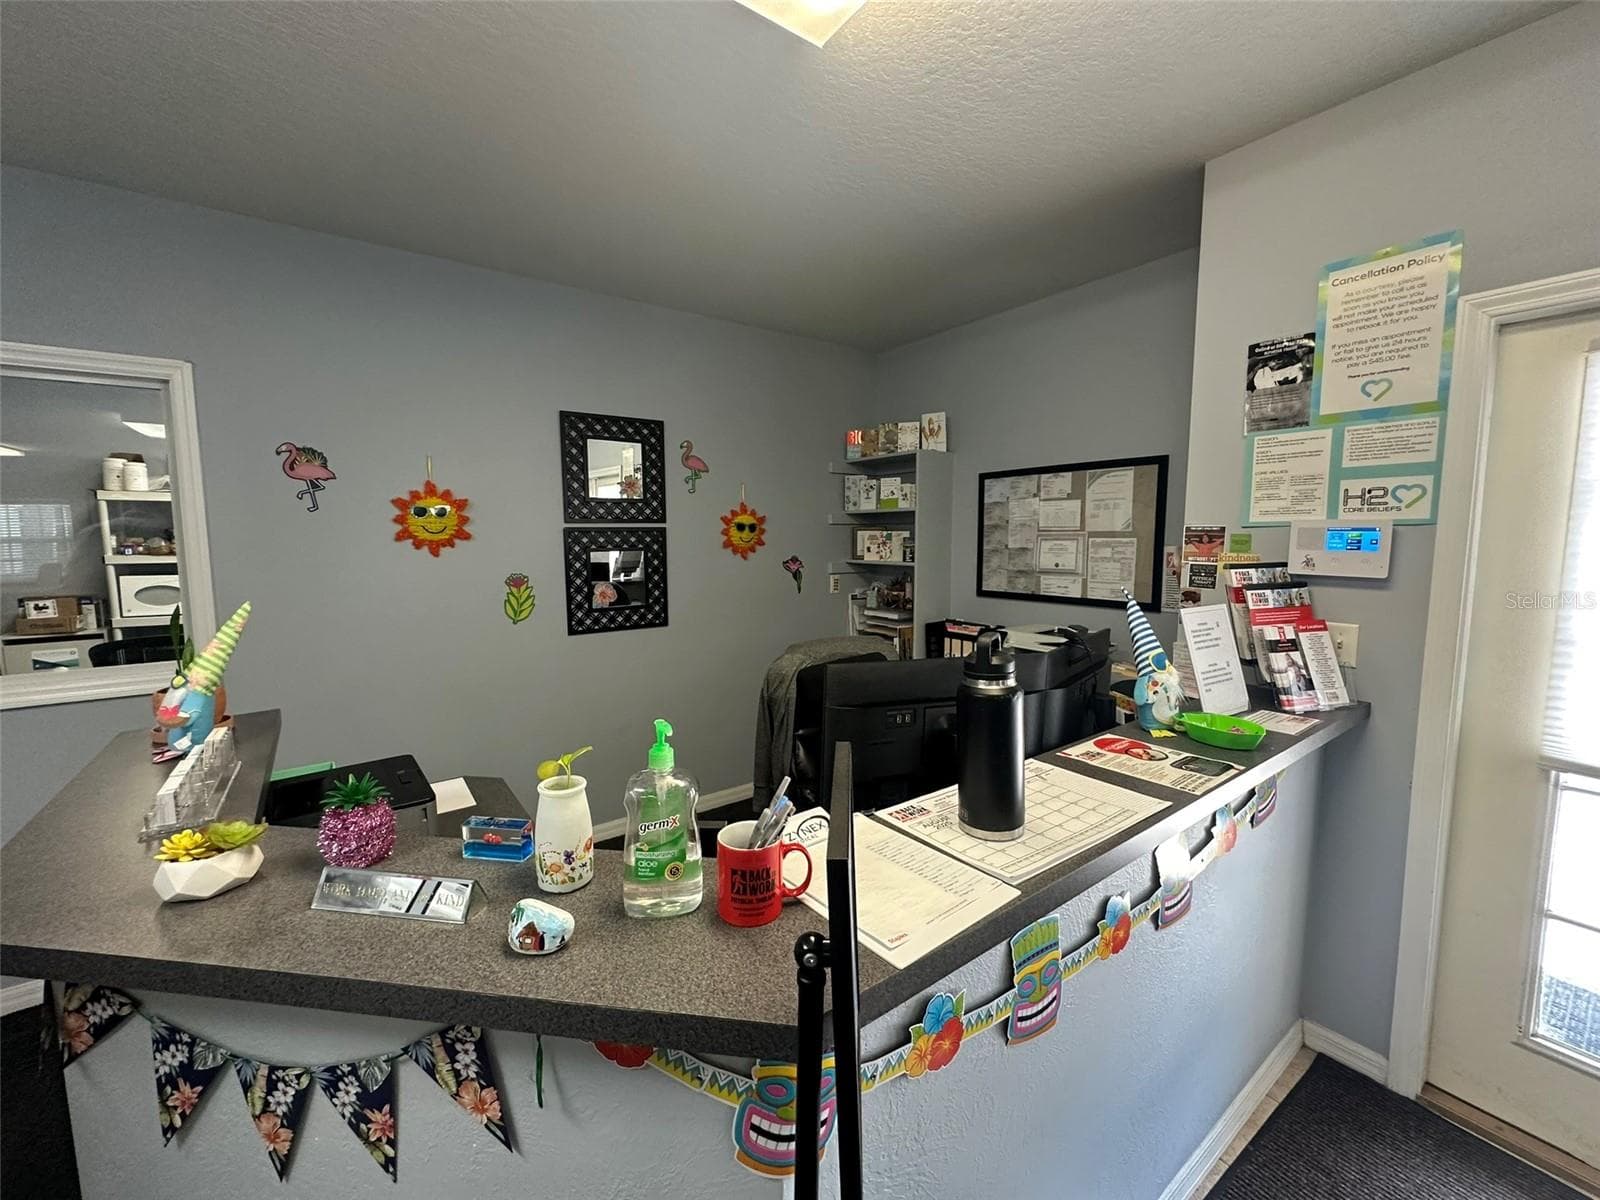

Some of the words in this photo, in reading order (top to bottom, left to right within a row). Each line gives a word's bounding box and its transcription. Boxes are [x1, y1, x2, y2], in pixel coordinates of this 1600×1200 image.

[1331, 264, 1404, 287] Cancellation
[1407, 253, 1445, 269] Policy
[1373, 298, 1387, 306] you
[1388, 295, 1408, 303] know
[1409, 291, 1425, 299] you
[1379, 304, 1396, 313] your
[1398, 294, 1439, 308] scheduled
[1411, 303, 1437, 313] happy
[1356, 321, 1382, 331] rebook
[1337, 342, 1351, 350] you
[1352, 338, 1368, 347] miss
[1381, 326, 1432, 342] appointment
[1343, 347, 1355, 355] fail
[1365, 344, 1380, 353] give
[1392, 339, 1403, 347] 24
[1405, 335, 1427, 344] hours
[1356, 352, 1370, 360] you
[1385, 344, 1419, 355] required
[1347, 361, 1361, 369] pay
[1366, 505, 1402, 513] BELIEFS
[1218, 553, 1260, 562] kindness
[785, 820, 826, 842] ZYNEX
[638, 860, 658, 868] aloe
[749, 866, 771, 882] BACK
[435, 893, 466, 908] KIND
